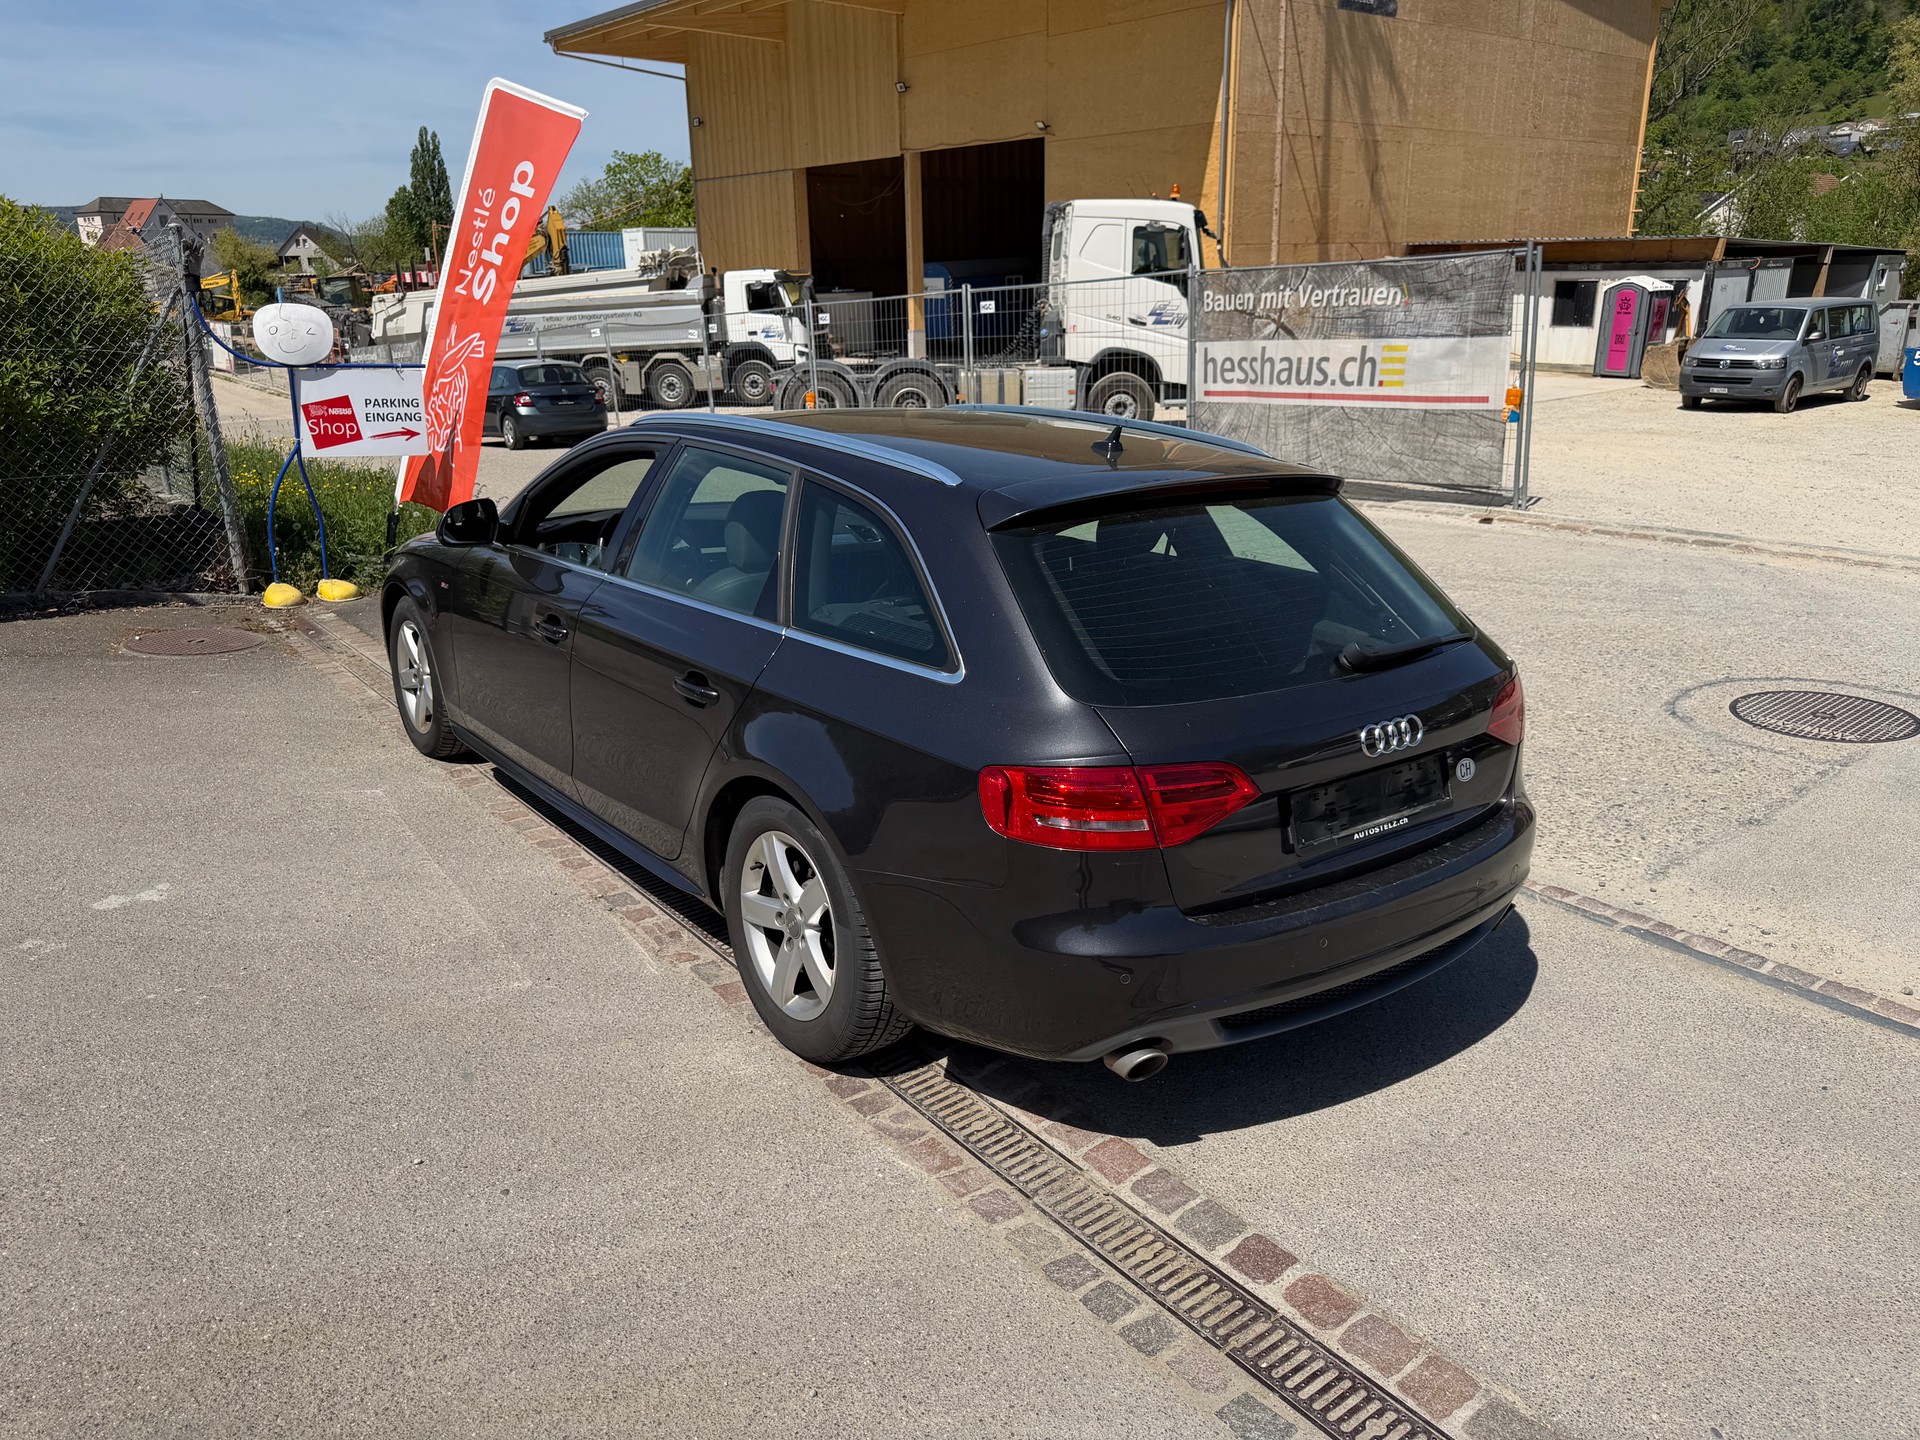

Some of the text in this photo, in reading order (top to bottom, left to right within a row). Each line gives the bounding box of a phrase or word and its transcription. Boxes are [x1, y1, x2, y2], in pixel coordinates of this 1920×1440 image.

[455, 187, 496, 296] Nestlé
[472, 160, 536, 306] Shop
[1203, 290, 1254, 313] Bauen
[1260, 285, 1291, 309] mit
[1203, 345, 1378, 388] hesshaus.ch
[364, 398, 420, 409] PARKING
[308, 418, 358, 439] Shop
[365, 412, 422, 423] EINGANG
[1459, 762, 1472, 778] CH
[1353, 817, 1409, 840] AUTOSTELZ.ch
